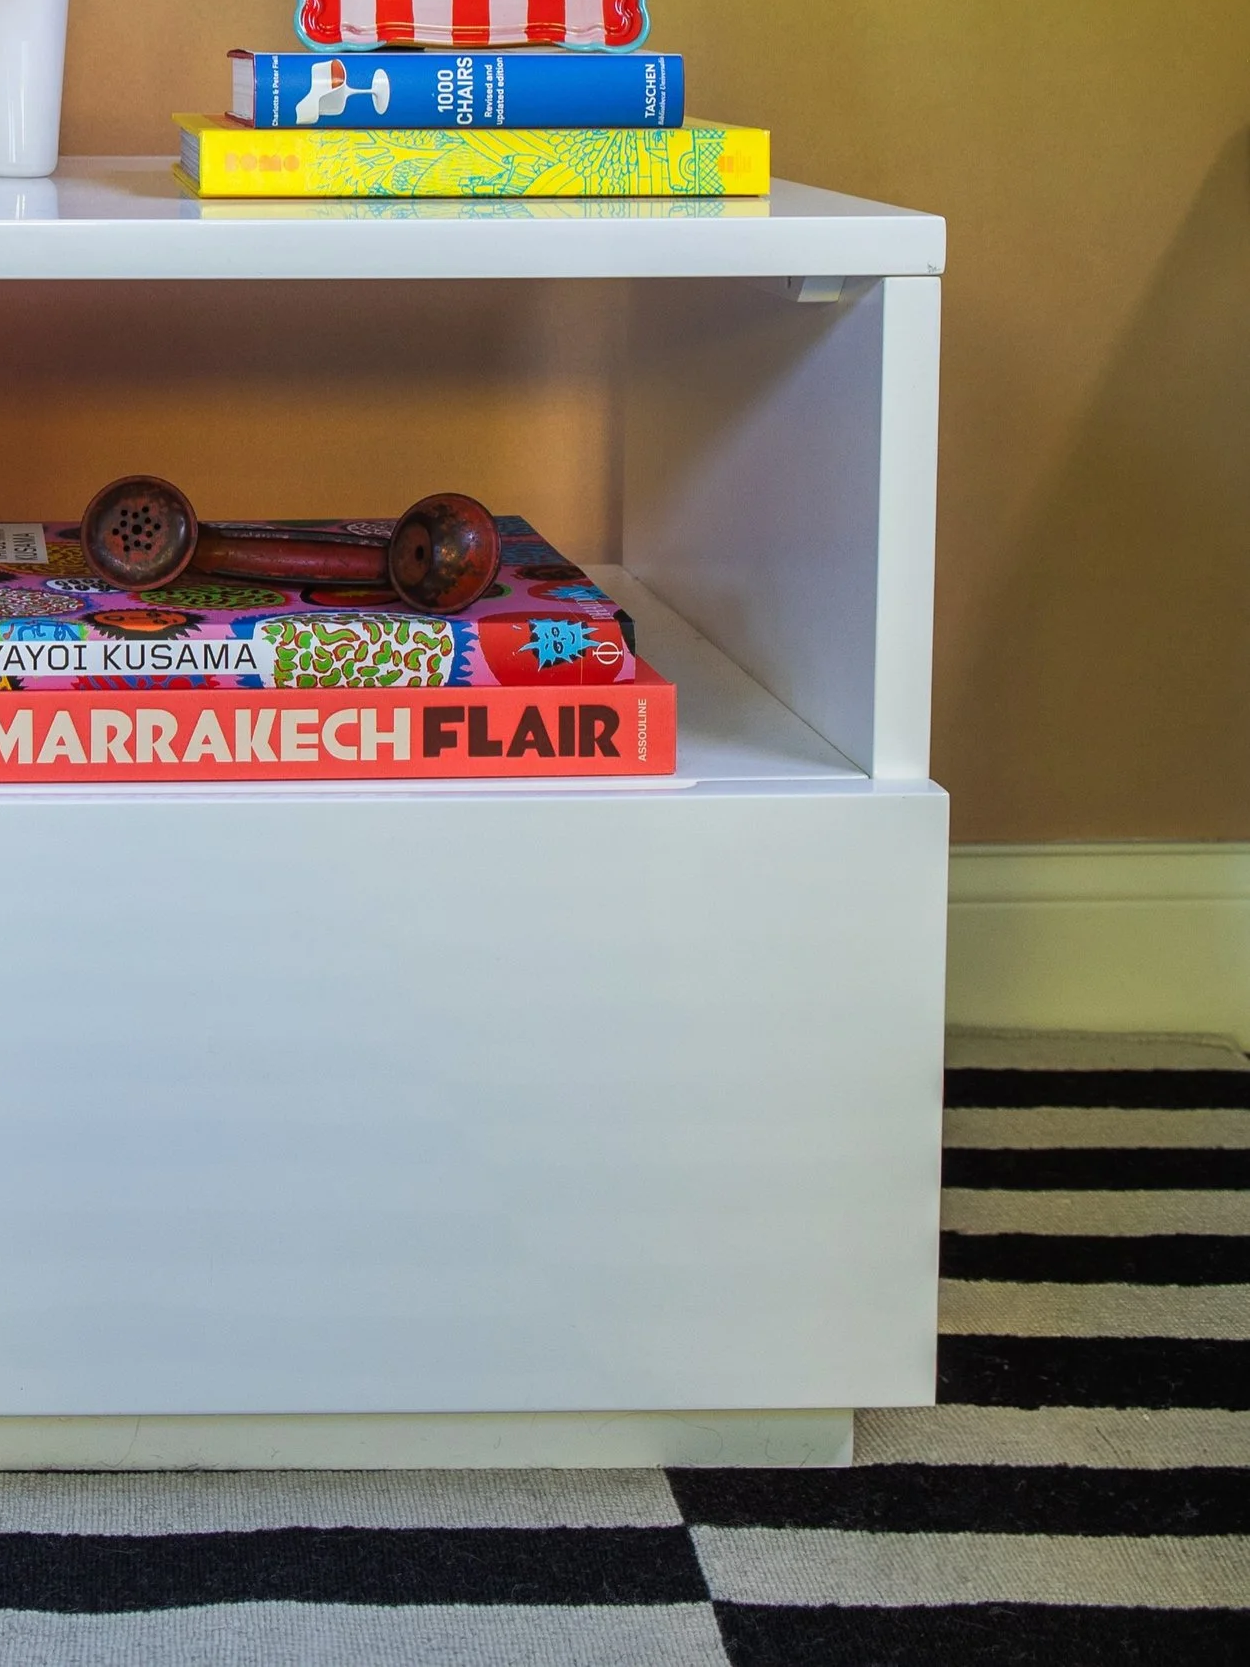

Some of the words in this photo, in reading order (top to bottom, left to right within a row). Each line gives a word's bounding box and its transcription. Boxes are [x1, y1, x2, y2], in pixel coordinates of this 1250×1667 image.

[484, 64, 493, 82] and
[496, 57, 505, 87] edition
[437, 70, 454, 113] 1000
[456, 57, 473, 125] CHAIRS
[484, 83, 493, 118] Revised
[496, 88, 505, 125] updated
[645, 63, 656, 119] TASCHEN
[12, 532, 39, 561] KUSAMA
[103, 643, 258, 671] KUSAMA
[423, 705, 622, 758] FLAIR
[637, 698, 648, 763] ASSOULINE
